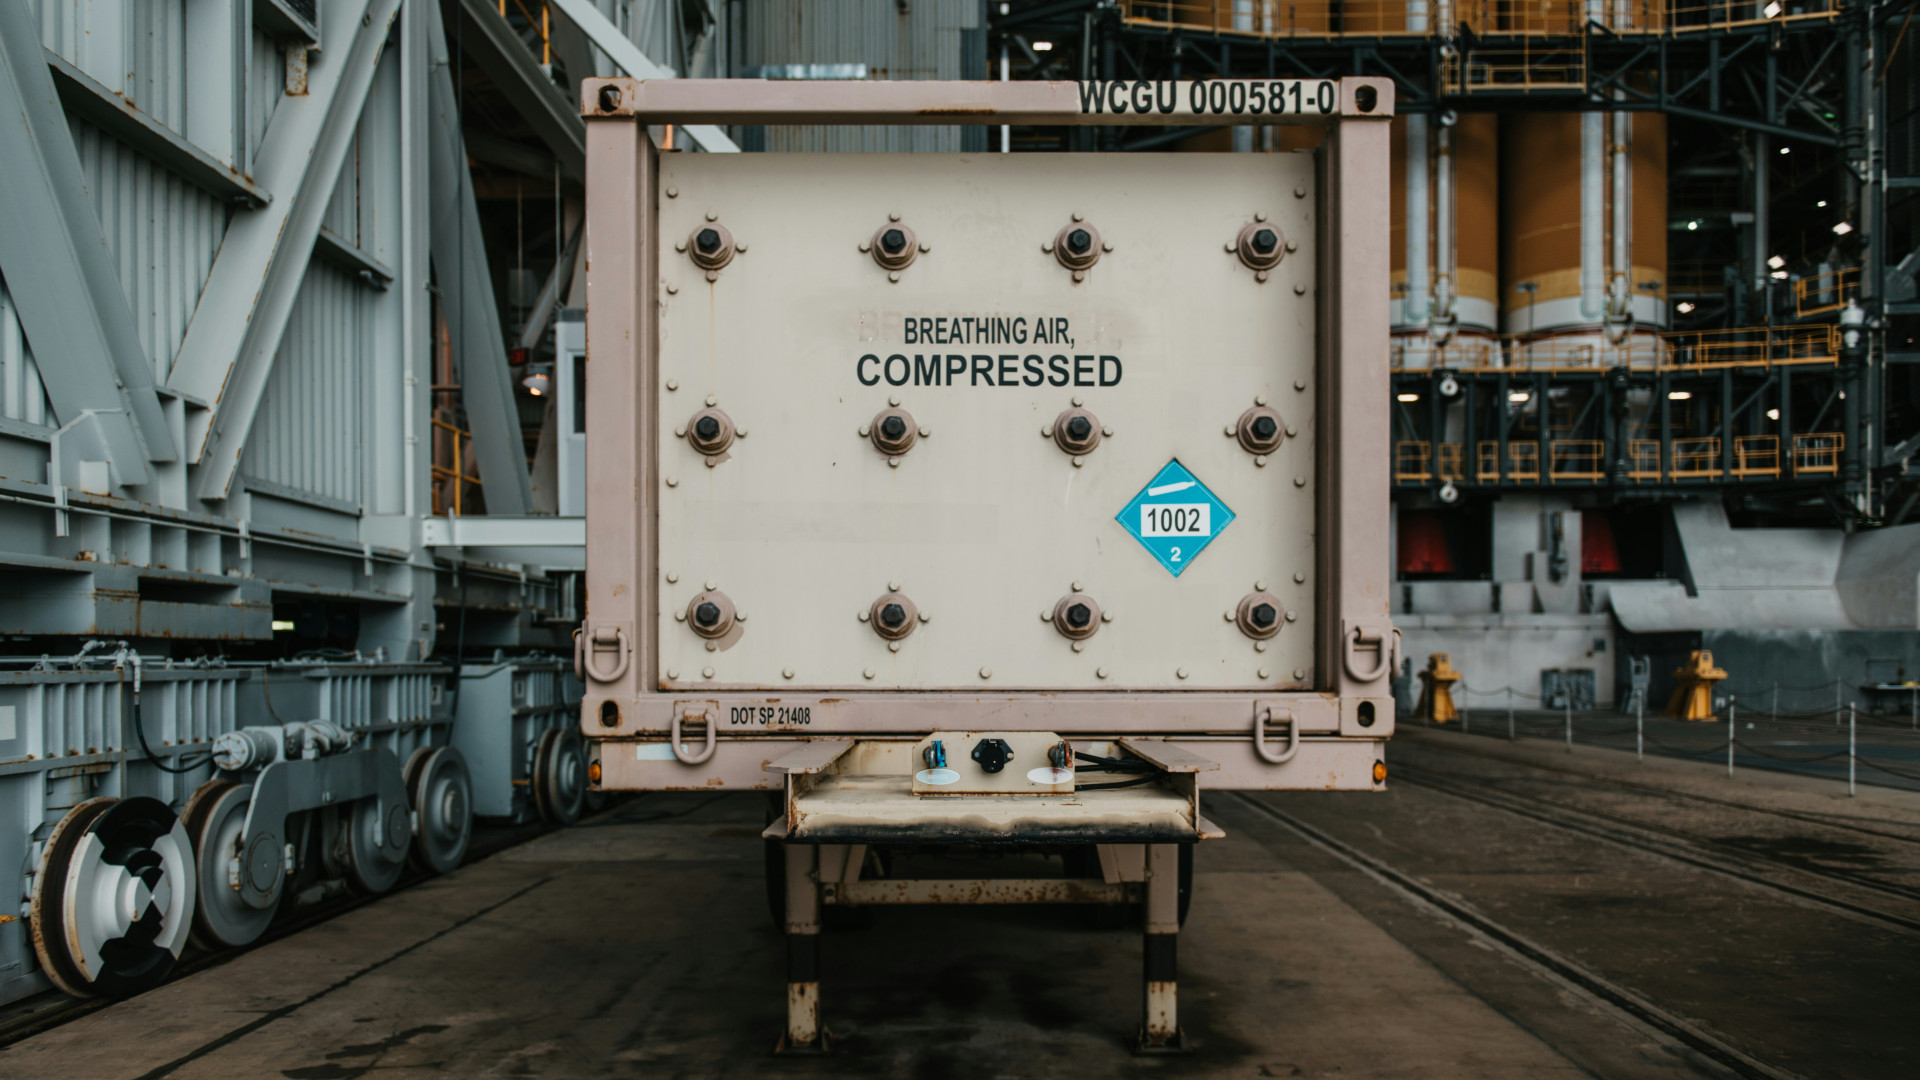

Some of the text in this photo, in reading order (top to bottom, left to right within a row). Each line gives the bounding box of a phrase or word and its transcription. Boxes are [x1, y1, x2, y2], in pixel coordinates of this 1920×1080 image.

[1078, 80, 1335, 115] WCGU 000581-0
[904, 317, 1028, 345] BREATHING
[1033, 317, 1075, 350] AIR,
[856, 353, 1123, 388] COMPRESSED
[1147, 507, 1201, 533] 1002
[1170, 546, 1182, 562] 2
[731, 706, 811, 725] DOT SP 21408
